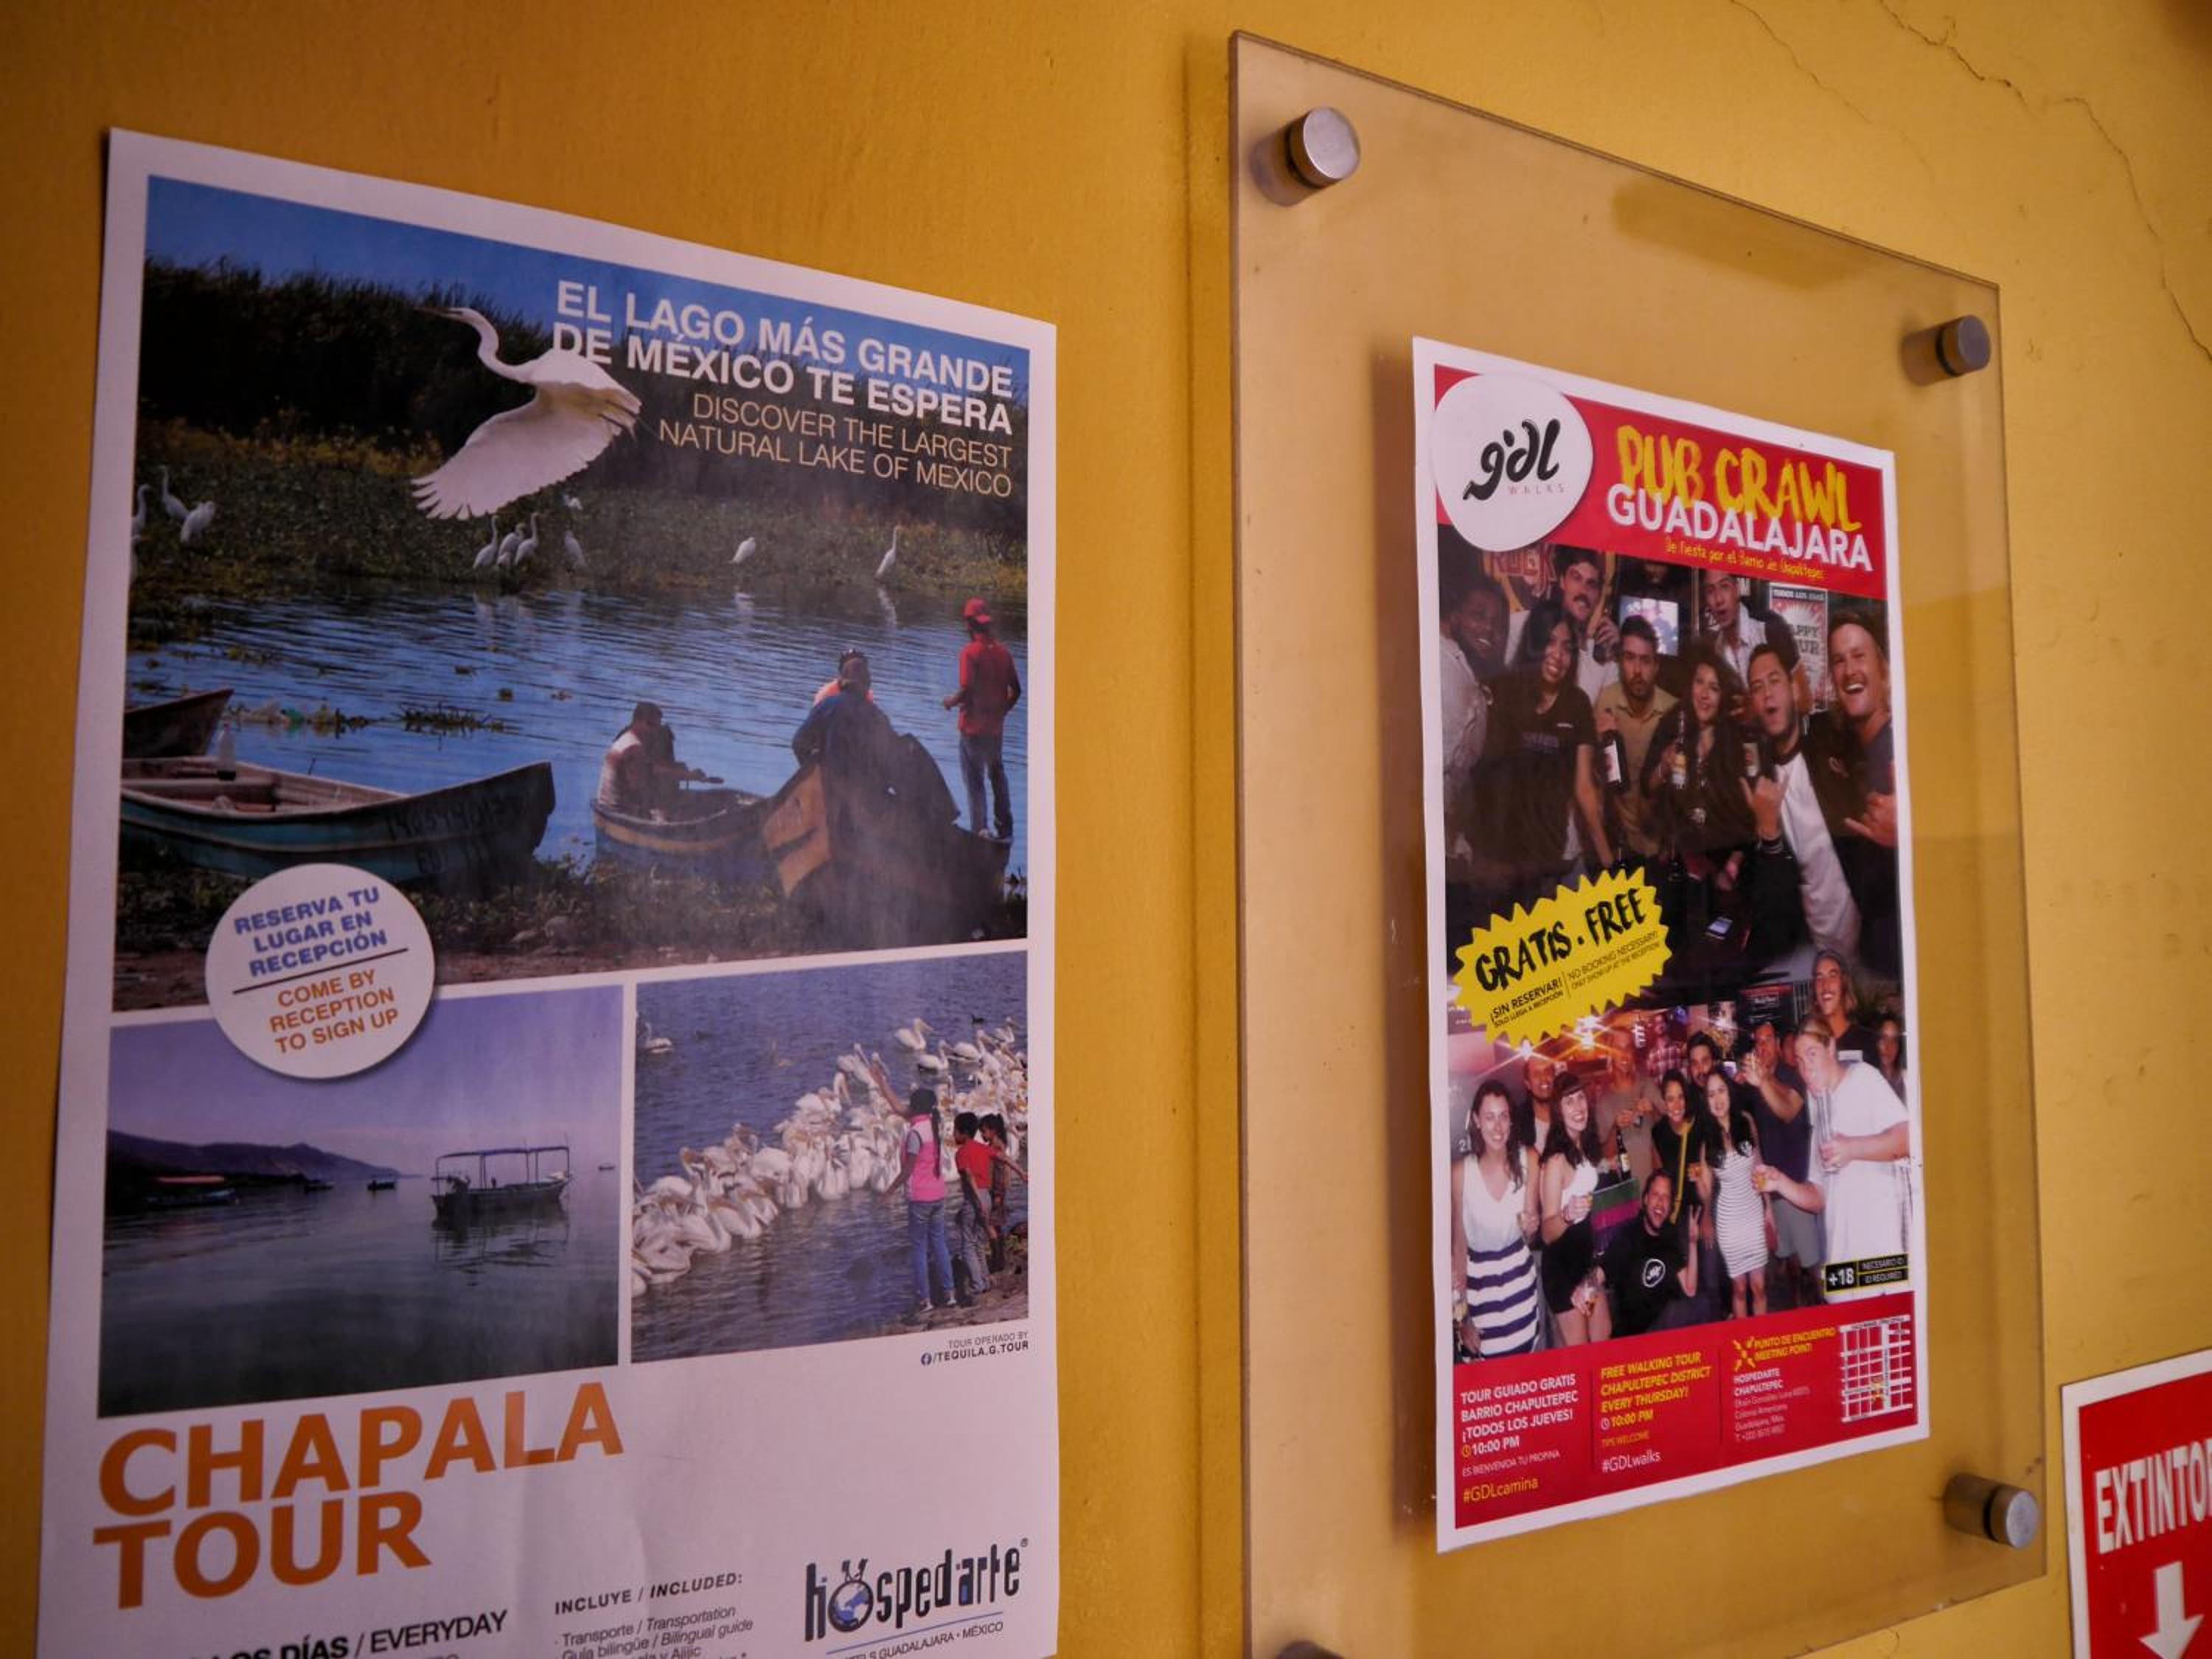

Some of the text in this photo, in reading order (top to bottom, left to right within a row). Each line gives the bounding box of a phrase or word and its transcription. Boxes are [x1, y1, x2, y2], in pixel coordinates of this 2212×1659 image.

[557, 280, 1012, 399] EL LAGO MÁS GRANDE
[553, 322, 1012, 435] DE MÉXICO TE ESPERA
[693, 394, 1012, 469] DISCOVER THE LARGEST
[659, 419, 1012, 498] NATURAL LAKE OF MEXICO
[1617, 425, 1863, 532] PUB CRAWL
[1607, 483, 1874, 572] GUADALAJARA
[234, 887, 380, 935] RESERVA TU
[254, 911, 372, 953] LUGAR EN
[249, 929, 388, 978] RECEPCIÓN
[1475, 888, 1647, 992] GRATIS FREE
[278, 969, 376, 1008] COME BY
[1490, 976, 1562, 1023] ¡SIN RESERVAR!
[269, 987, 395, 1033] RECEPTION
[274, 1008, 399, 1054] TO SIGN UP
[1829, 1267, 1854, 1286] +18
[948, 1339, 973, 1349] TOUR
[1601, 1352, 1702, 1380] FREE WALKING TOUR
[1601, 1366, 1711, 1397] CHAPULTEPEC DISTRICT
[1461, 1374, 1576, 1405] TOUR GUIADO GRATIS
[1461, 1391, 1579, 1422] BARRIO CHAPULTEPEC
[1601, 1397, 1634, 1414] EVERY
[1462, 1408, 1573, 1443] ¡TODOS LOS JUEVES!
[1611, 1409, 1655, 1428] 10:00 PM
[97, 1382, 625, 1517] CHAPALA
[1472, 1435, 1520, 1455] 10:00 PM
[1602, 1450, 1662, 1473] #GDLwalks
[1463, 1477, 1539, 1504] #GDLcamina
[93, 1491, 432, 1610] TOUR
[554, 1590, 633, 1615] INCLUYE
[650, 1573, 742, 1599] INCLUDED:
[370, 1610, 508, 1654] EVERYDAY
[563, 1621, 634, 1647] Transporte
[647, 1605, 737, 1632] Transportation
[598, 1637, 650, 1658] bilingüe
[661, 1624, 716, 1646] Bilingual
[718, 1618, 754, 1638] guide
[879, 1632, 954, 1659] GUADALAJARA
